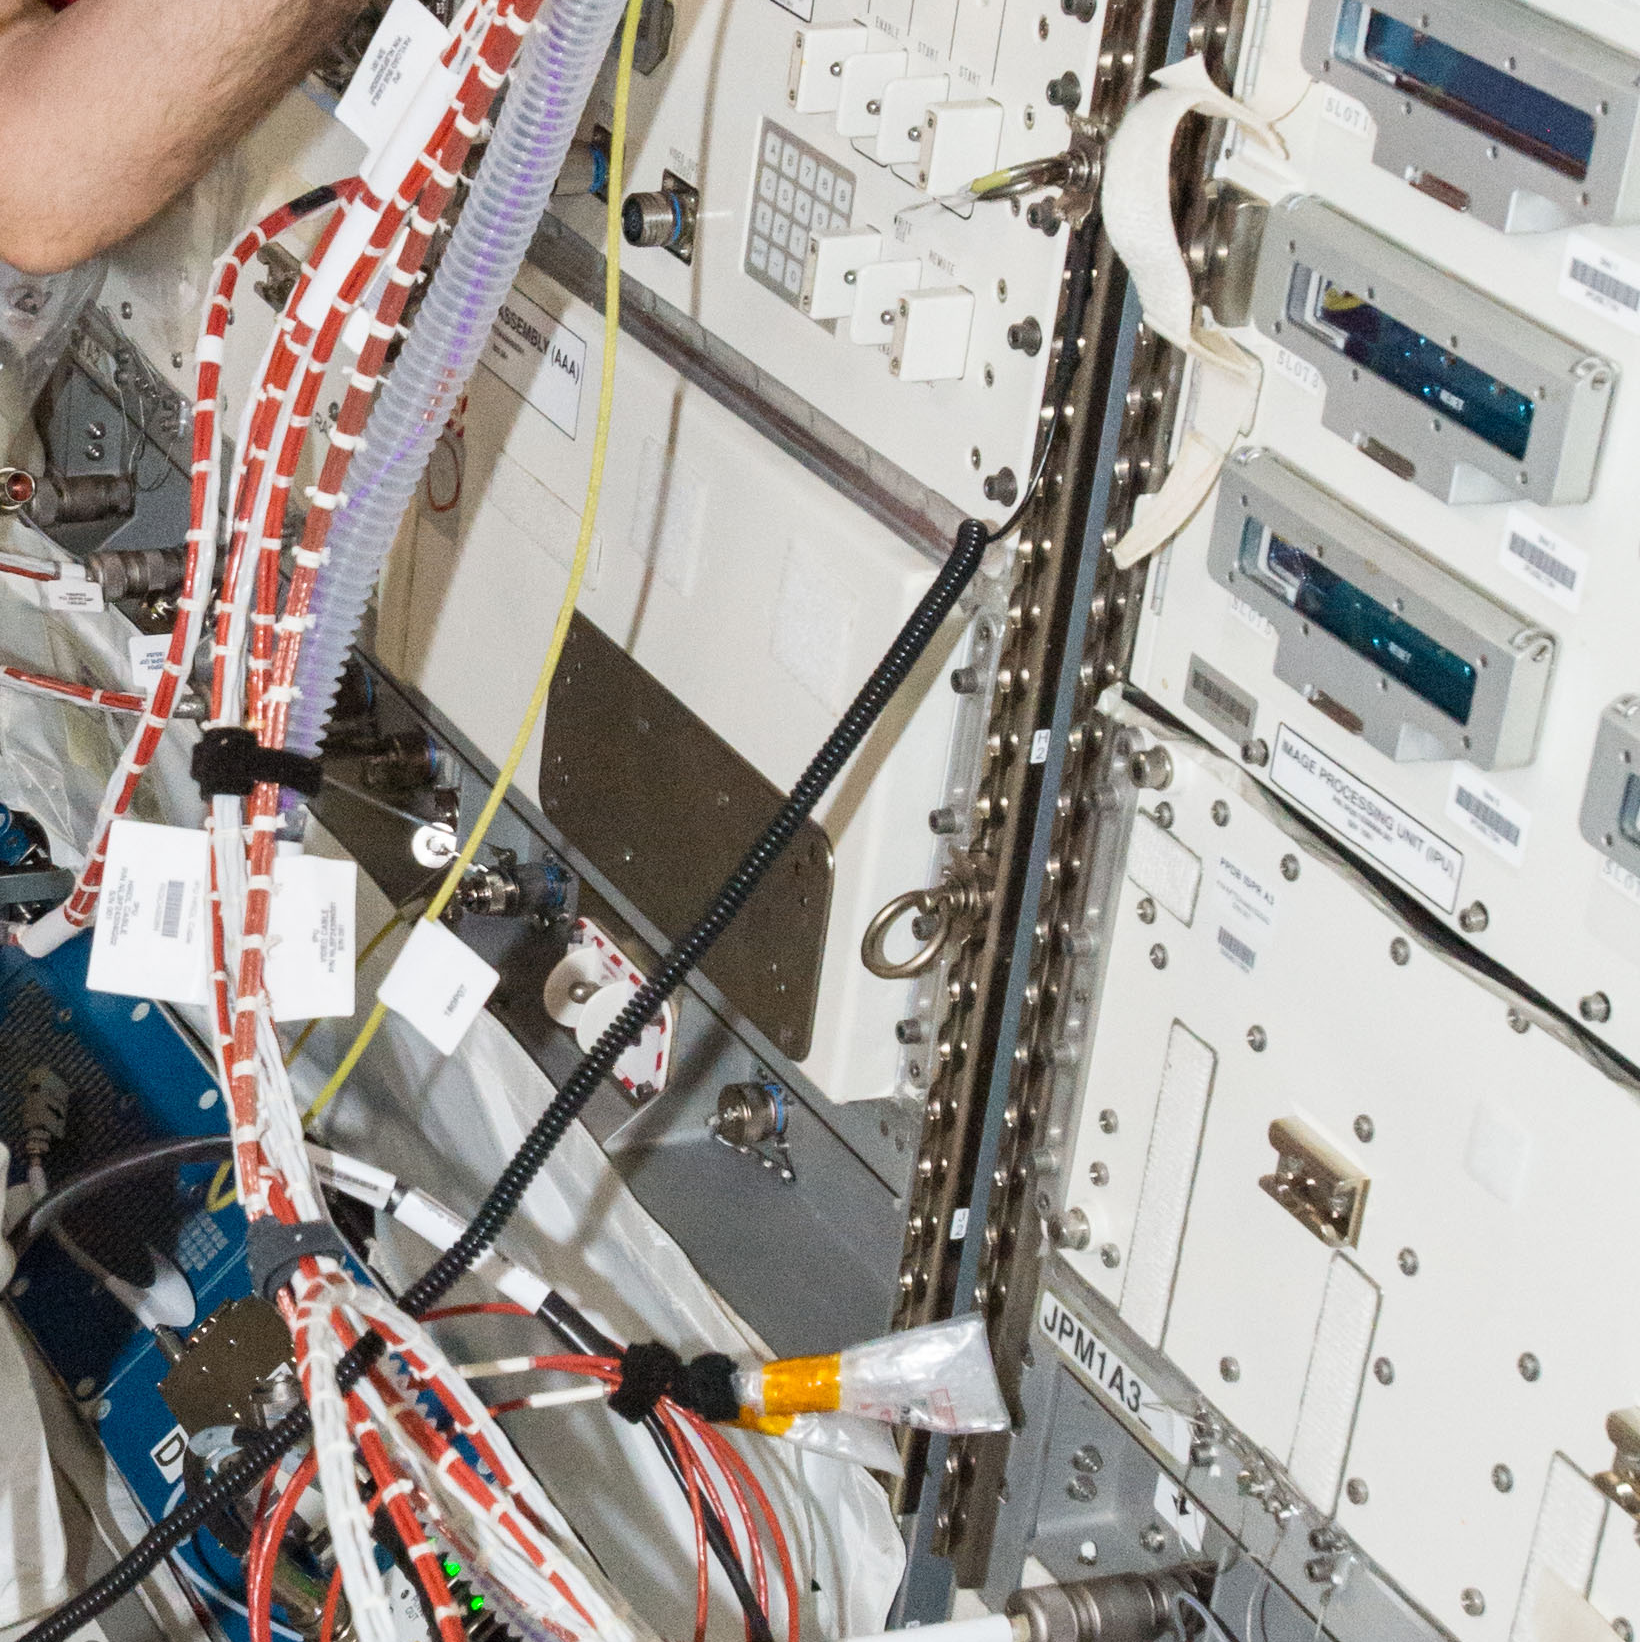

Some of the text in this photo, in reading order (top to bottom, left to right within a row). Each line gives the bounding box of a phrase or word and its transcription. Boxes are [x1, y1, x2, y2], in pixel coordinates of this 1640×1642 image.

[915, 39, 939, 62] START
[956, 63, 982, 88] START
[1325, 89, 1360, 133] SLOT
[927, 248, 956, 276] REMOTE
[551, 341, 582, 387] (AAA)
[1277, 347, 1310, 384] SLOT
[1035, 747, 1045, 759] 2
[1037, 731, 1048, 742] H
[1280, 738, 1317, 775] IMAGE
[1318, 766, 1395, 833] PROCESSING
[1395, 822, 1424, 854] UNIT
[1424, 842, 1455, 879] (IPU)
[118, 879, 135, 935] HRDL CABLE
[318, 908, 330, 962] VIDEO CABLE
[151, 1427, 190, 1472] D
